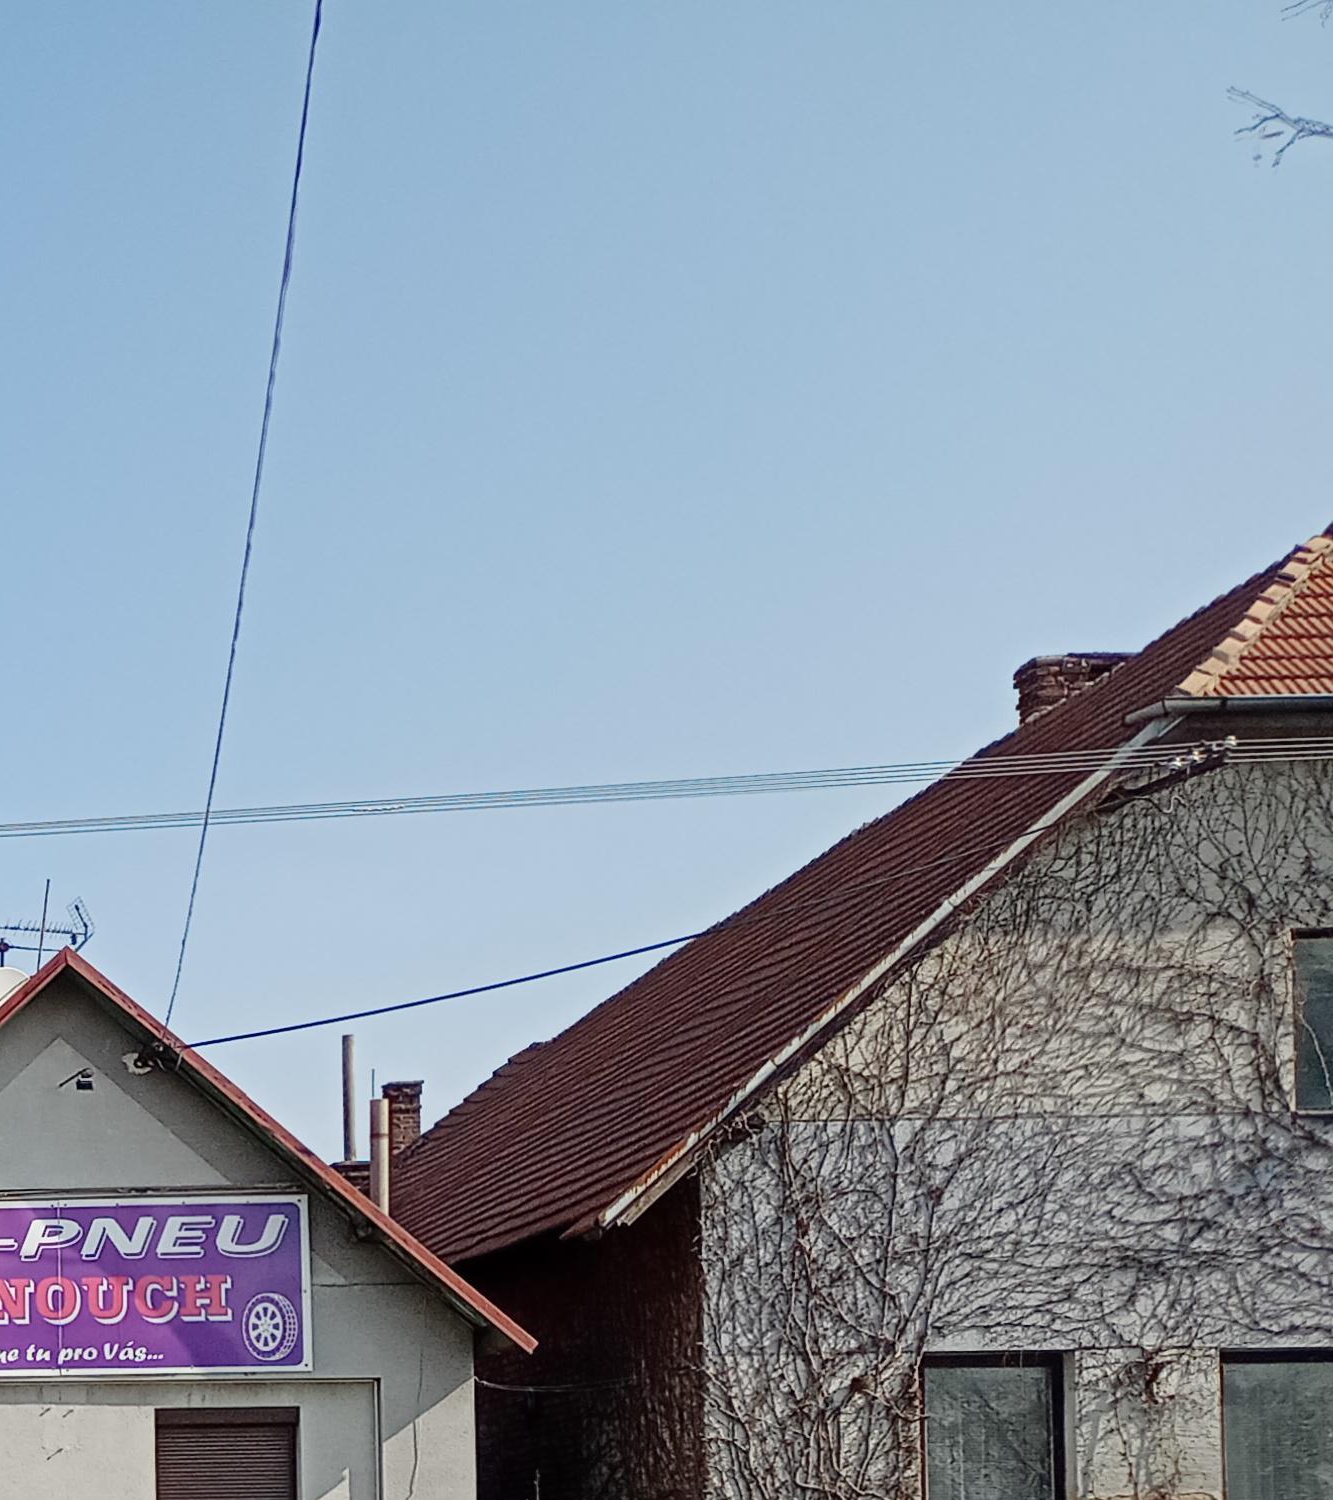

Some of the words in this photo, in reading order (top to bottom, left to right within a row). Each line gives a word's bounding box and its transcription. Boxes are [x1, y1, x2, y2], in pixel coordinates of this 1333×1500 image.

[26, 1344, 51, 1362] tu
[57, 1345, 99, 1365] pro
[103, 1341, 164, 1362] Vás...
